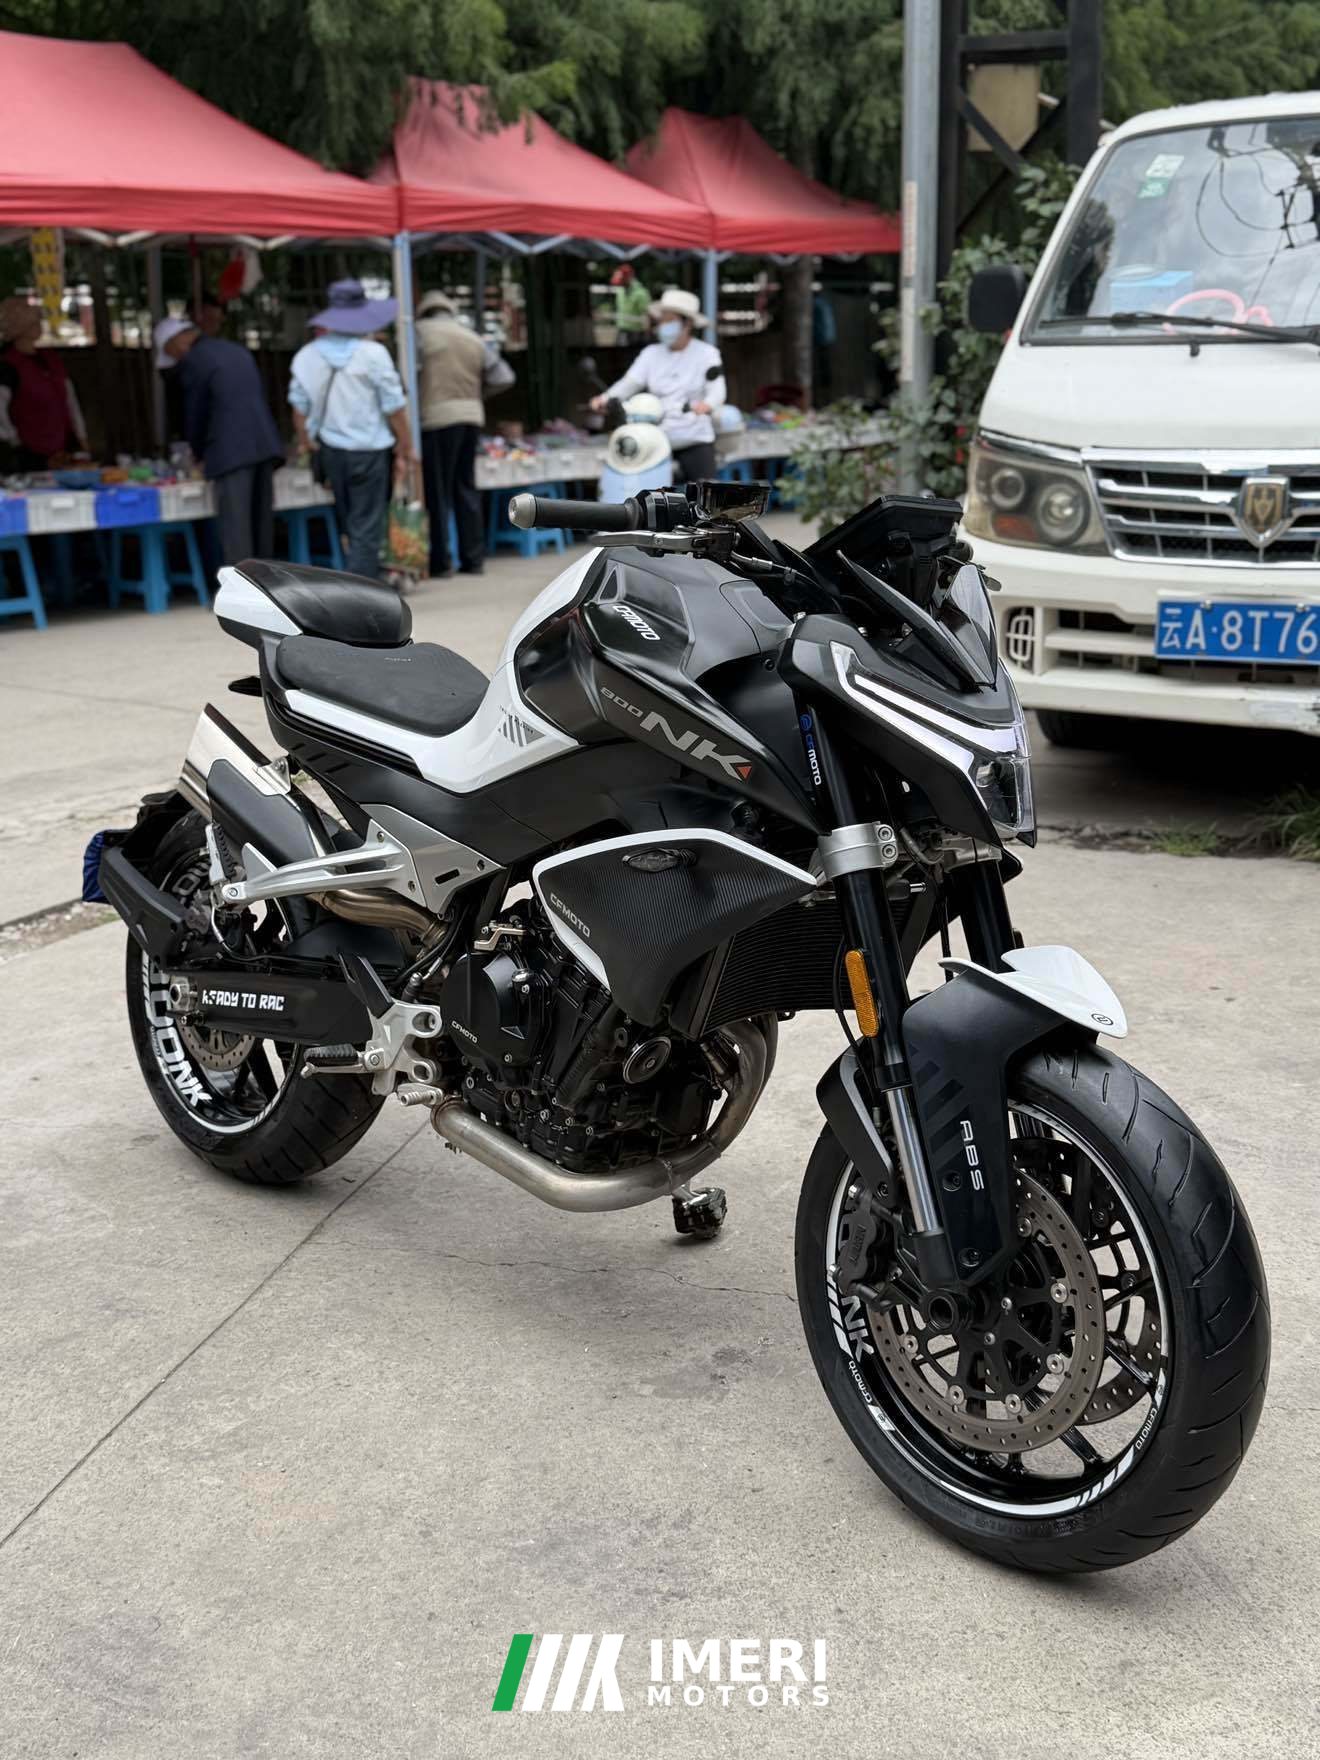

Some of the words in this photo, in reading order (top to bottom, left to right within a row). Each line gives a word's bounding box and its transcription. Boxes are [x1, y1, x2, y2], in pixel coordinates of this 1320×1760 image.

[640, 711, 751, 782] NK
[549, 893, 591, 938] CFMOTO
[241, 993, 257, 1009] TO
[451, 1020, 479, 1044] CFMOTO
[960, 1120, 985, 1191] ABS
[841, 1295, 875, 1363] NK
